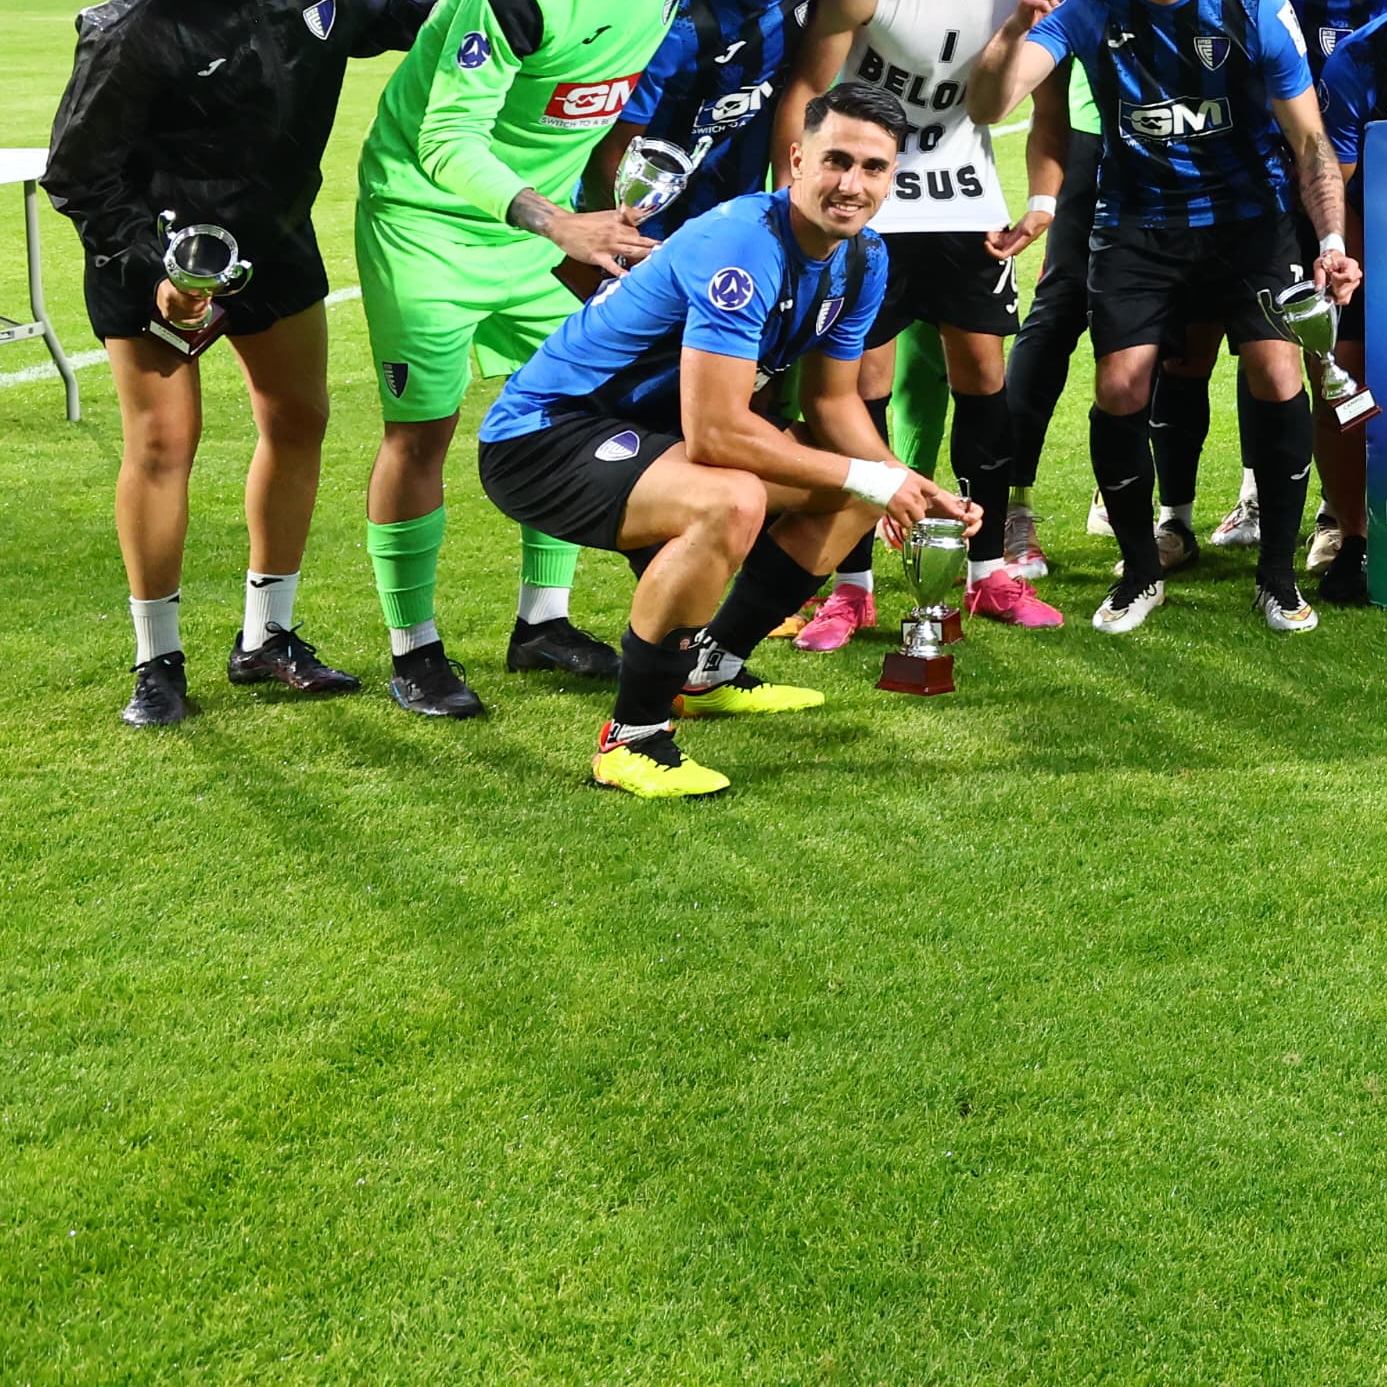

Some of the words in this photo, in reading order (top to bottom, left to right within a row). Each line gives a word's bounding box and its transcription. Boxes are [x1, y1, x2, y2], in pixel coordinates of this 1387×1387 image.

[939, 29, 960, 63] I
[856, 46, 969, 112] BELO
[541, 116, 576, 128] SWITCH
[1131, 100, 1222, 136] GM
[895, 163, 985, 202] SUS
